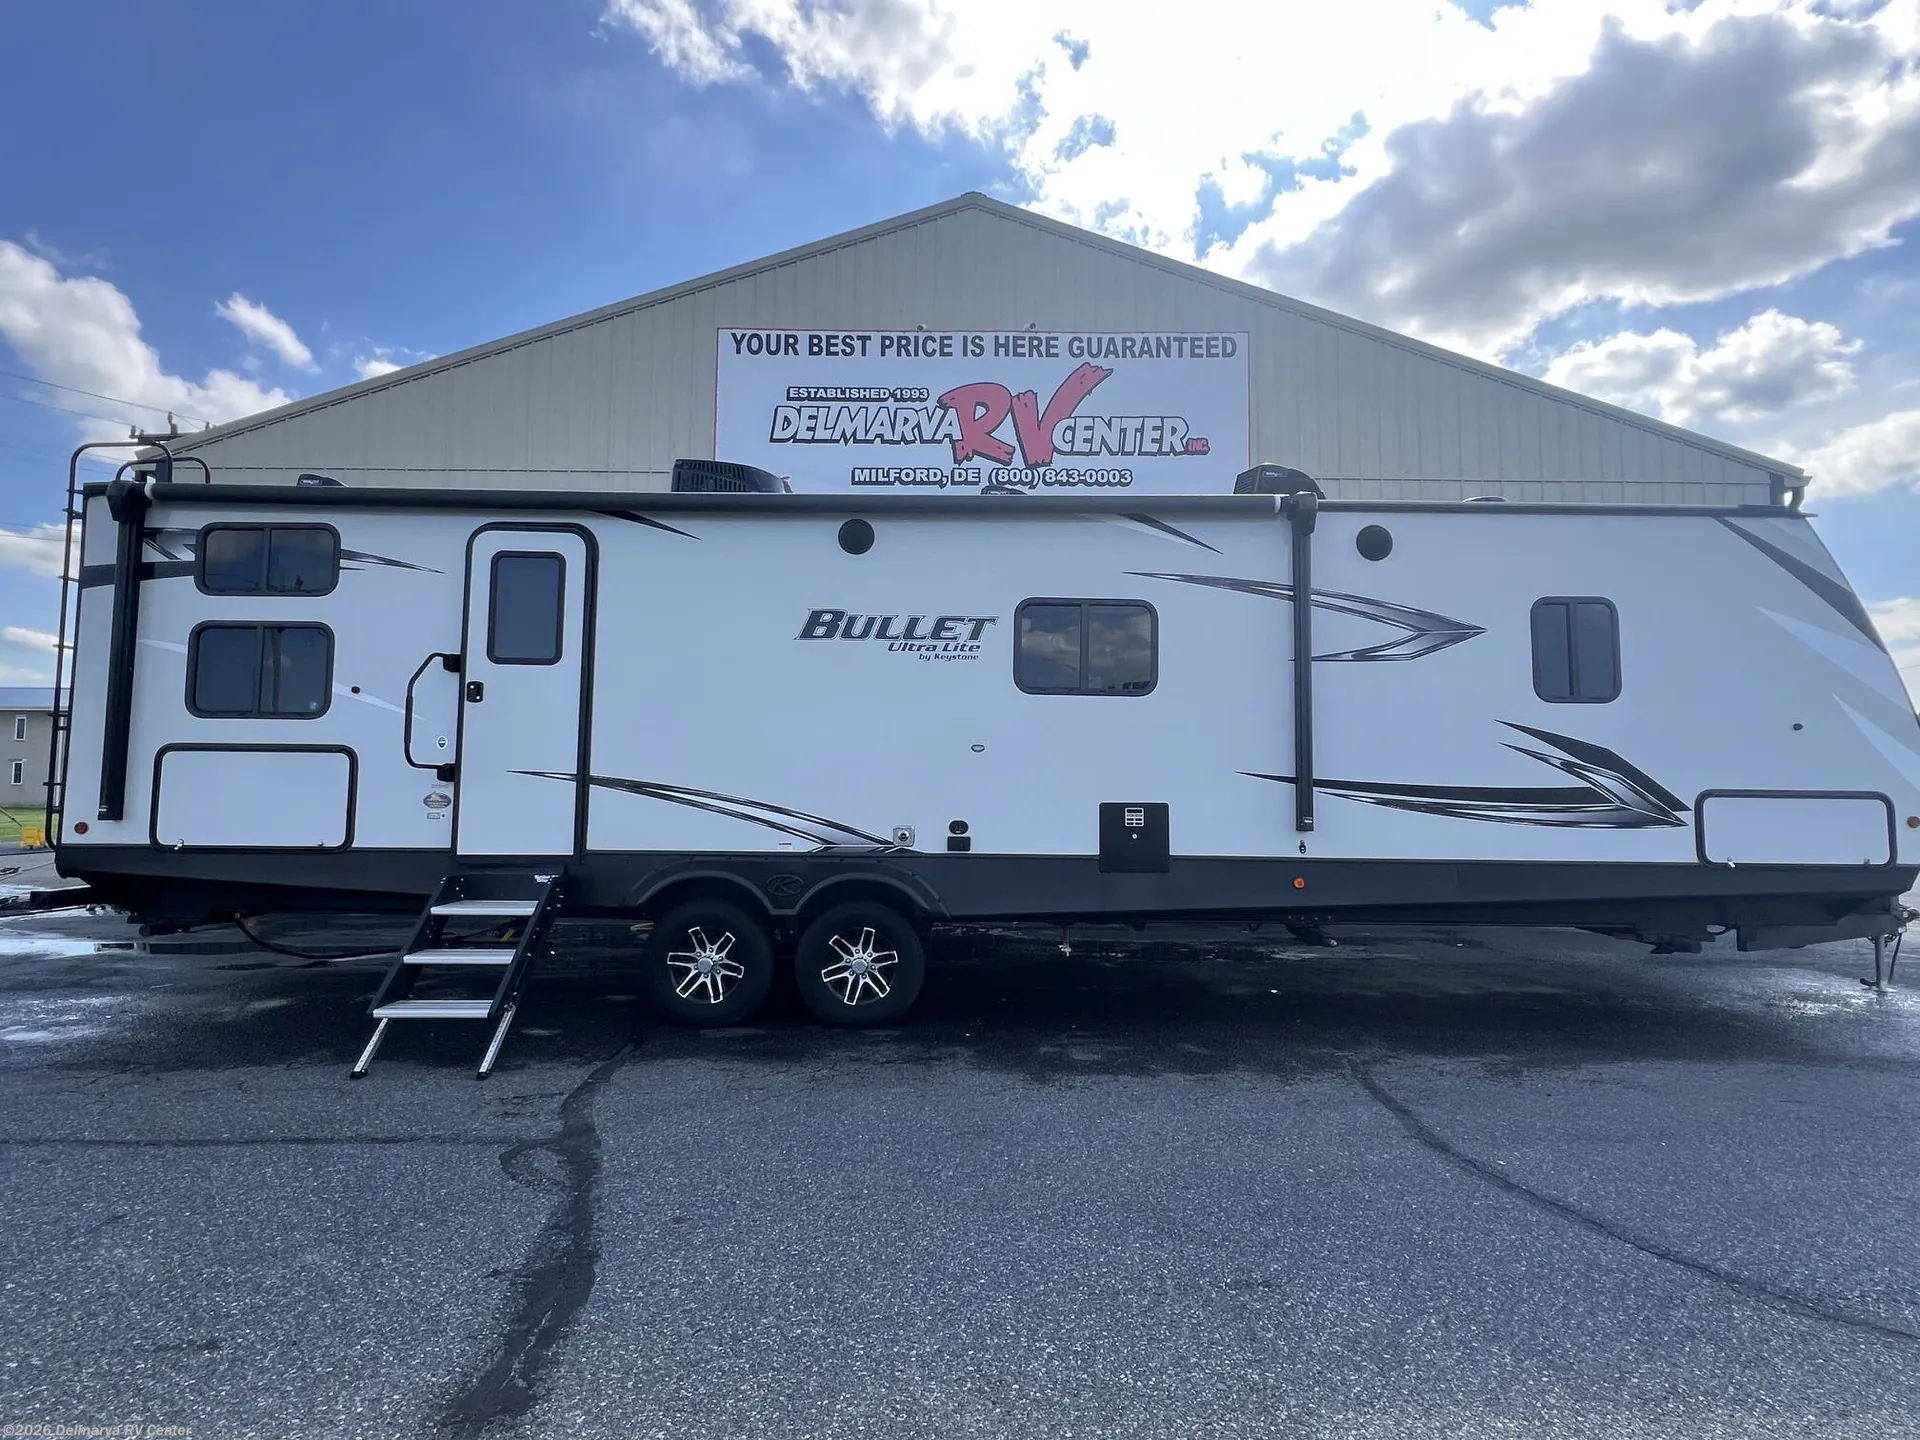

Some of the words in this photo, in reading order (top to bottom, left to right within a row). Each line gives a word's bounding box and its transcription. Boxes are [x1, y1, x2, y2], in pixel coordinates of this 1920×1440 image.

[731, 332, 799, 356] YOUR
[808, 334, 872, 356] BEST
[880, 335, 953, 357] PRICE
[962, 336, 985, 357] IS
[994, 336, 1059, 358] HERE
[1068, 336, 1237, 359] GUARANTEED
[787, 386, 891, 401] ESTABLISHED
[892, 388, 929, 402] 1993
[769, 405, 964, 445] DELMARVA
[937, 362, 1113, 468] RV
[1051, 416, 1189, 456] CENTER
[851, 467, 948, 488] MILFORD,
[952, 468, 981, 485] DE
[988, 467, 1040, 488] (800)
[1042, 468, 1133, 487] 843-0003
[888, 641, 937, 652] Ultra
[942, 642, 981, 652] Lite
[918, 653, 931, 661] by
[934, 653, 979, 661] Keystone
